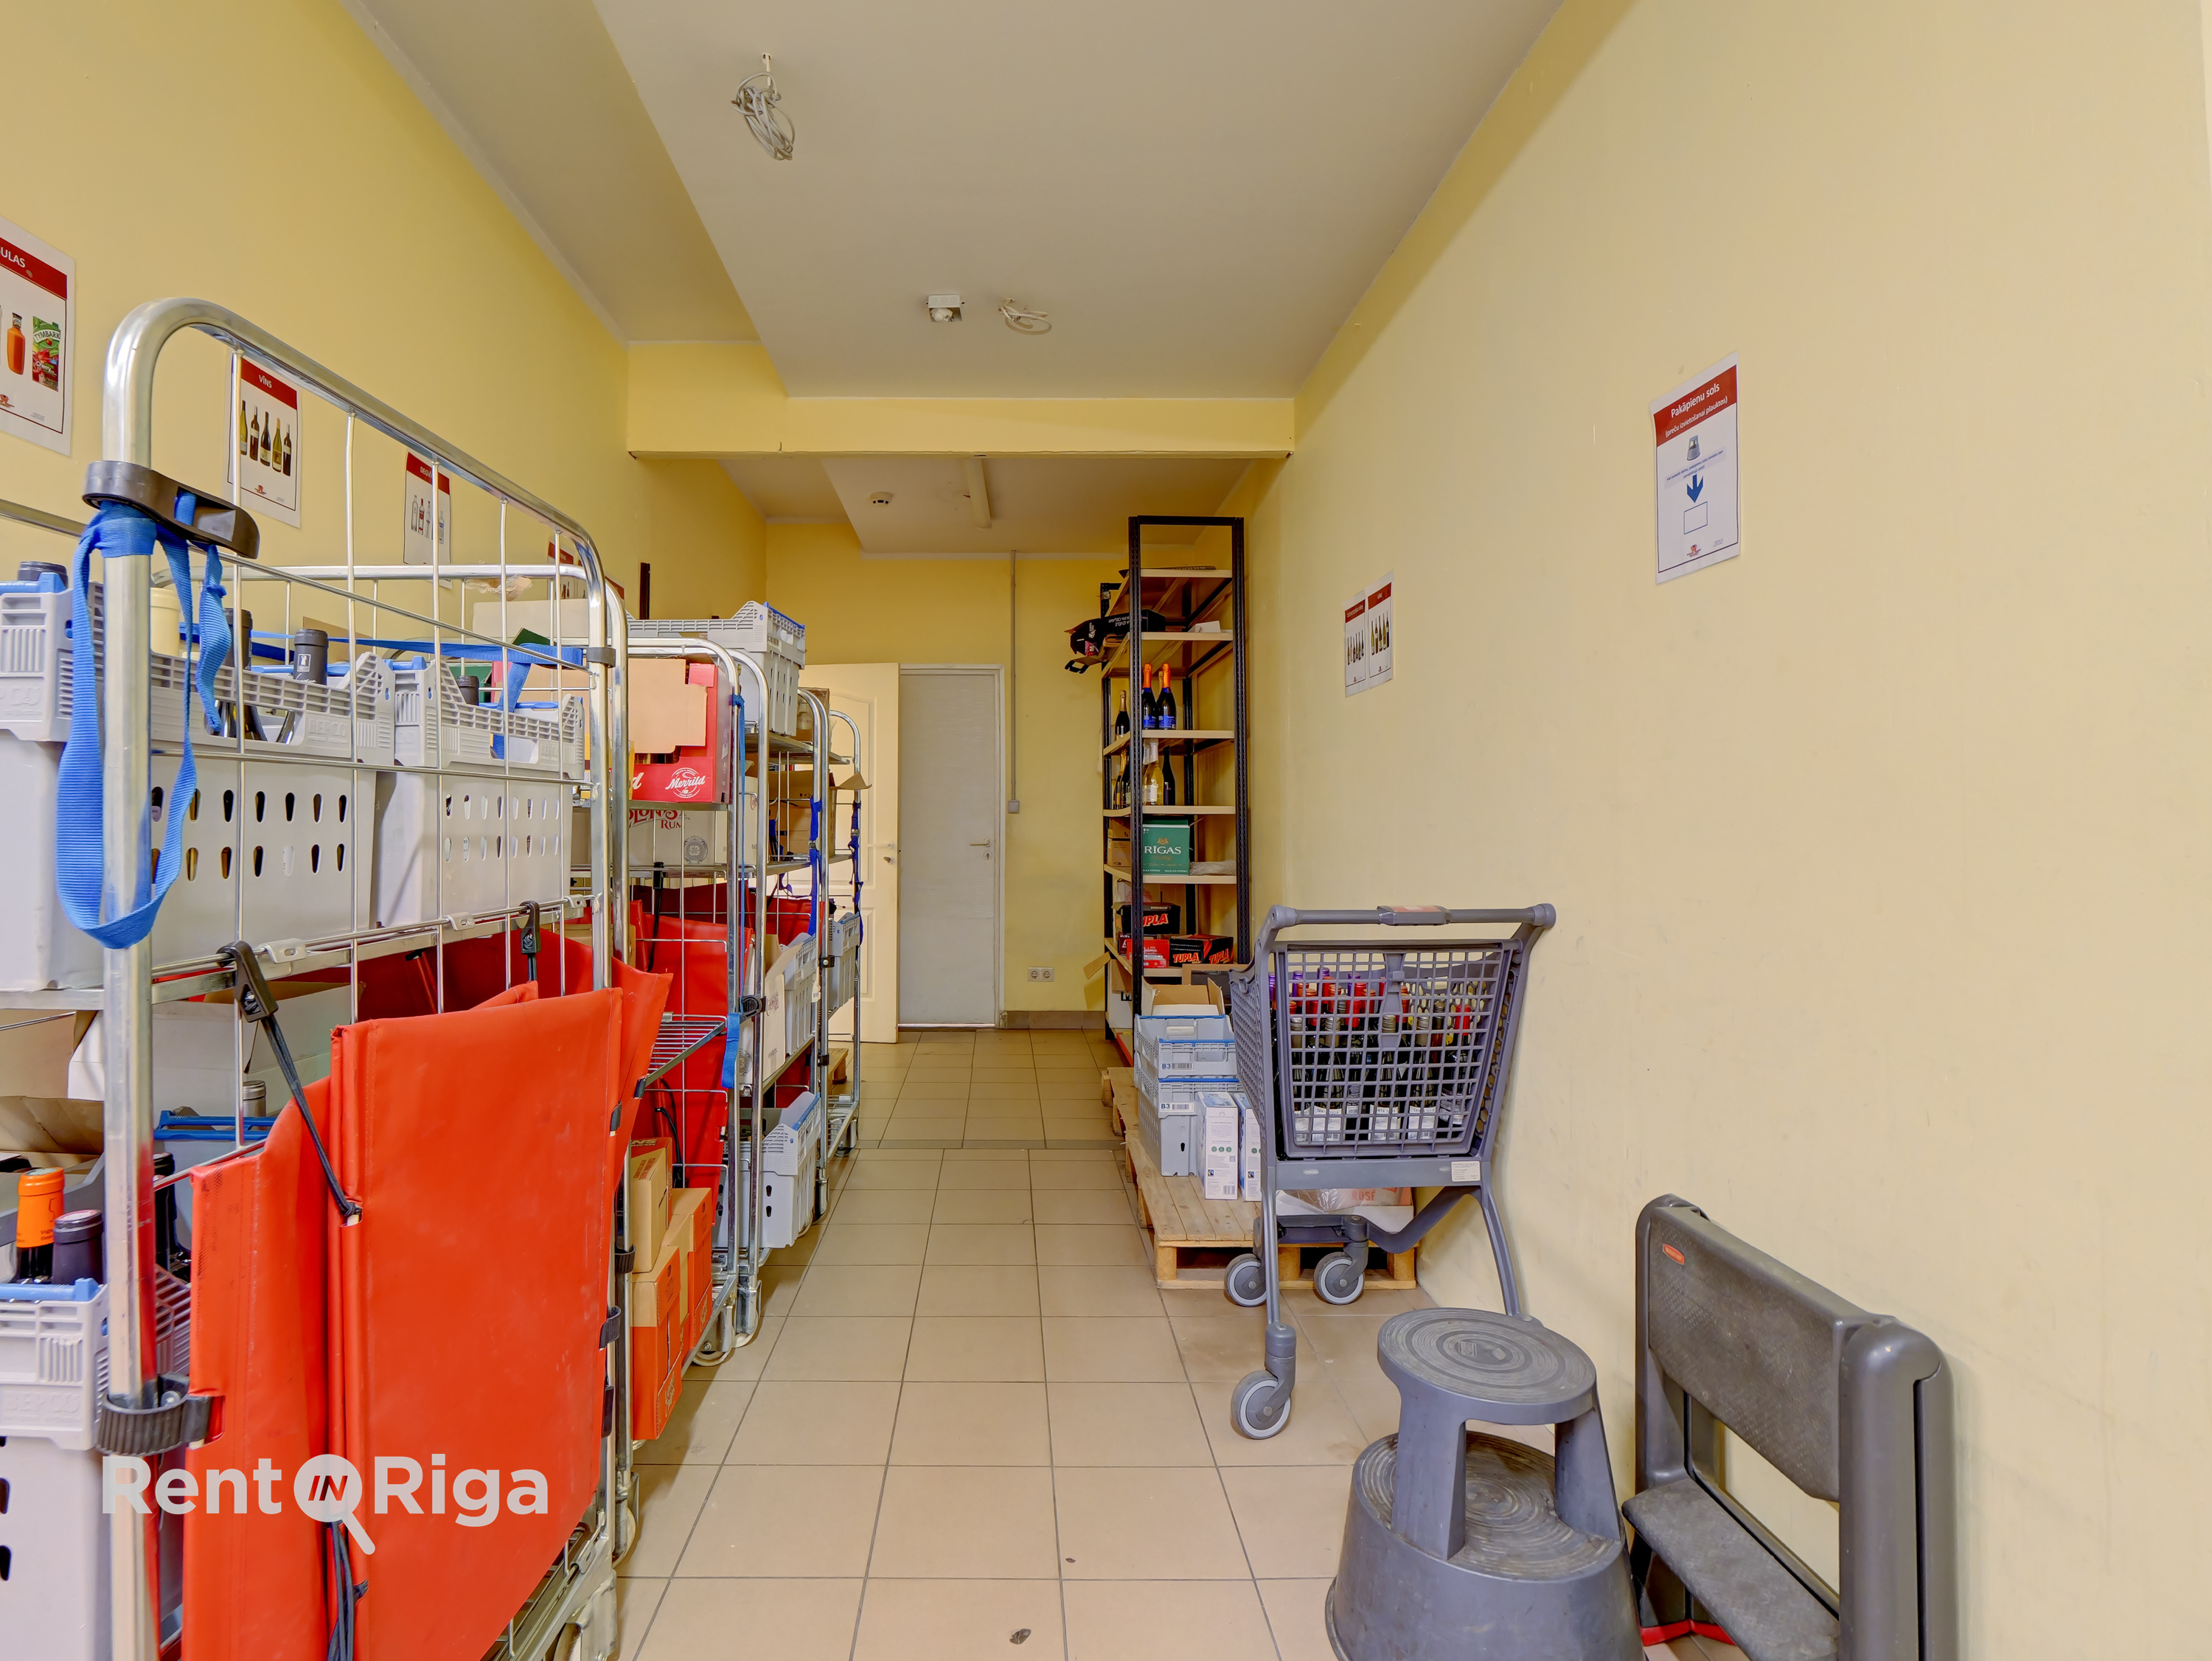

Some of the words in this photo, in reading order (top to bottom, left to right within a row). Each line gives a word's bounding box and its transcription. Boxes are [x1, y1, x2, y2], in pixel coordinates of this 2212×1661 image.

[0, 246, 26, 268] ULAS
[34, 330, 60, 341] TYMBARK
[258, 374, 272, 389] VĪNS
[1671, 393, 1705, 418] Pakāpienu
[1706, 383, 1719, 397] sols
[1665, 425, 1680, 438] (preču
[1680, 408, 1705, 429] izvietošanai
[1705, 395, 1728, 415] plauktos)
[665, 775, 706, 790] Merrild
[1144, 846, 1182, 854] RĪGAS
[1173, 952, 1200, 964] TUPLA
[1209, 948, 1229, 964] TUPLA
